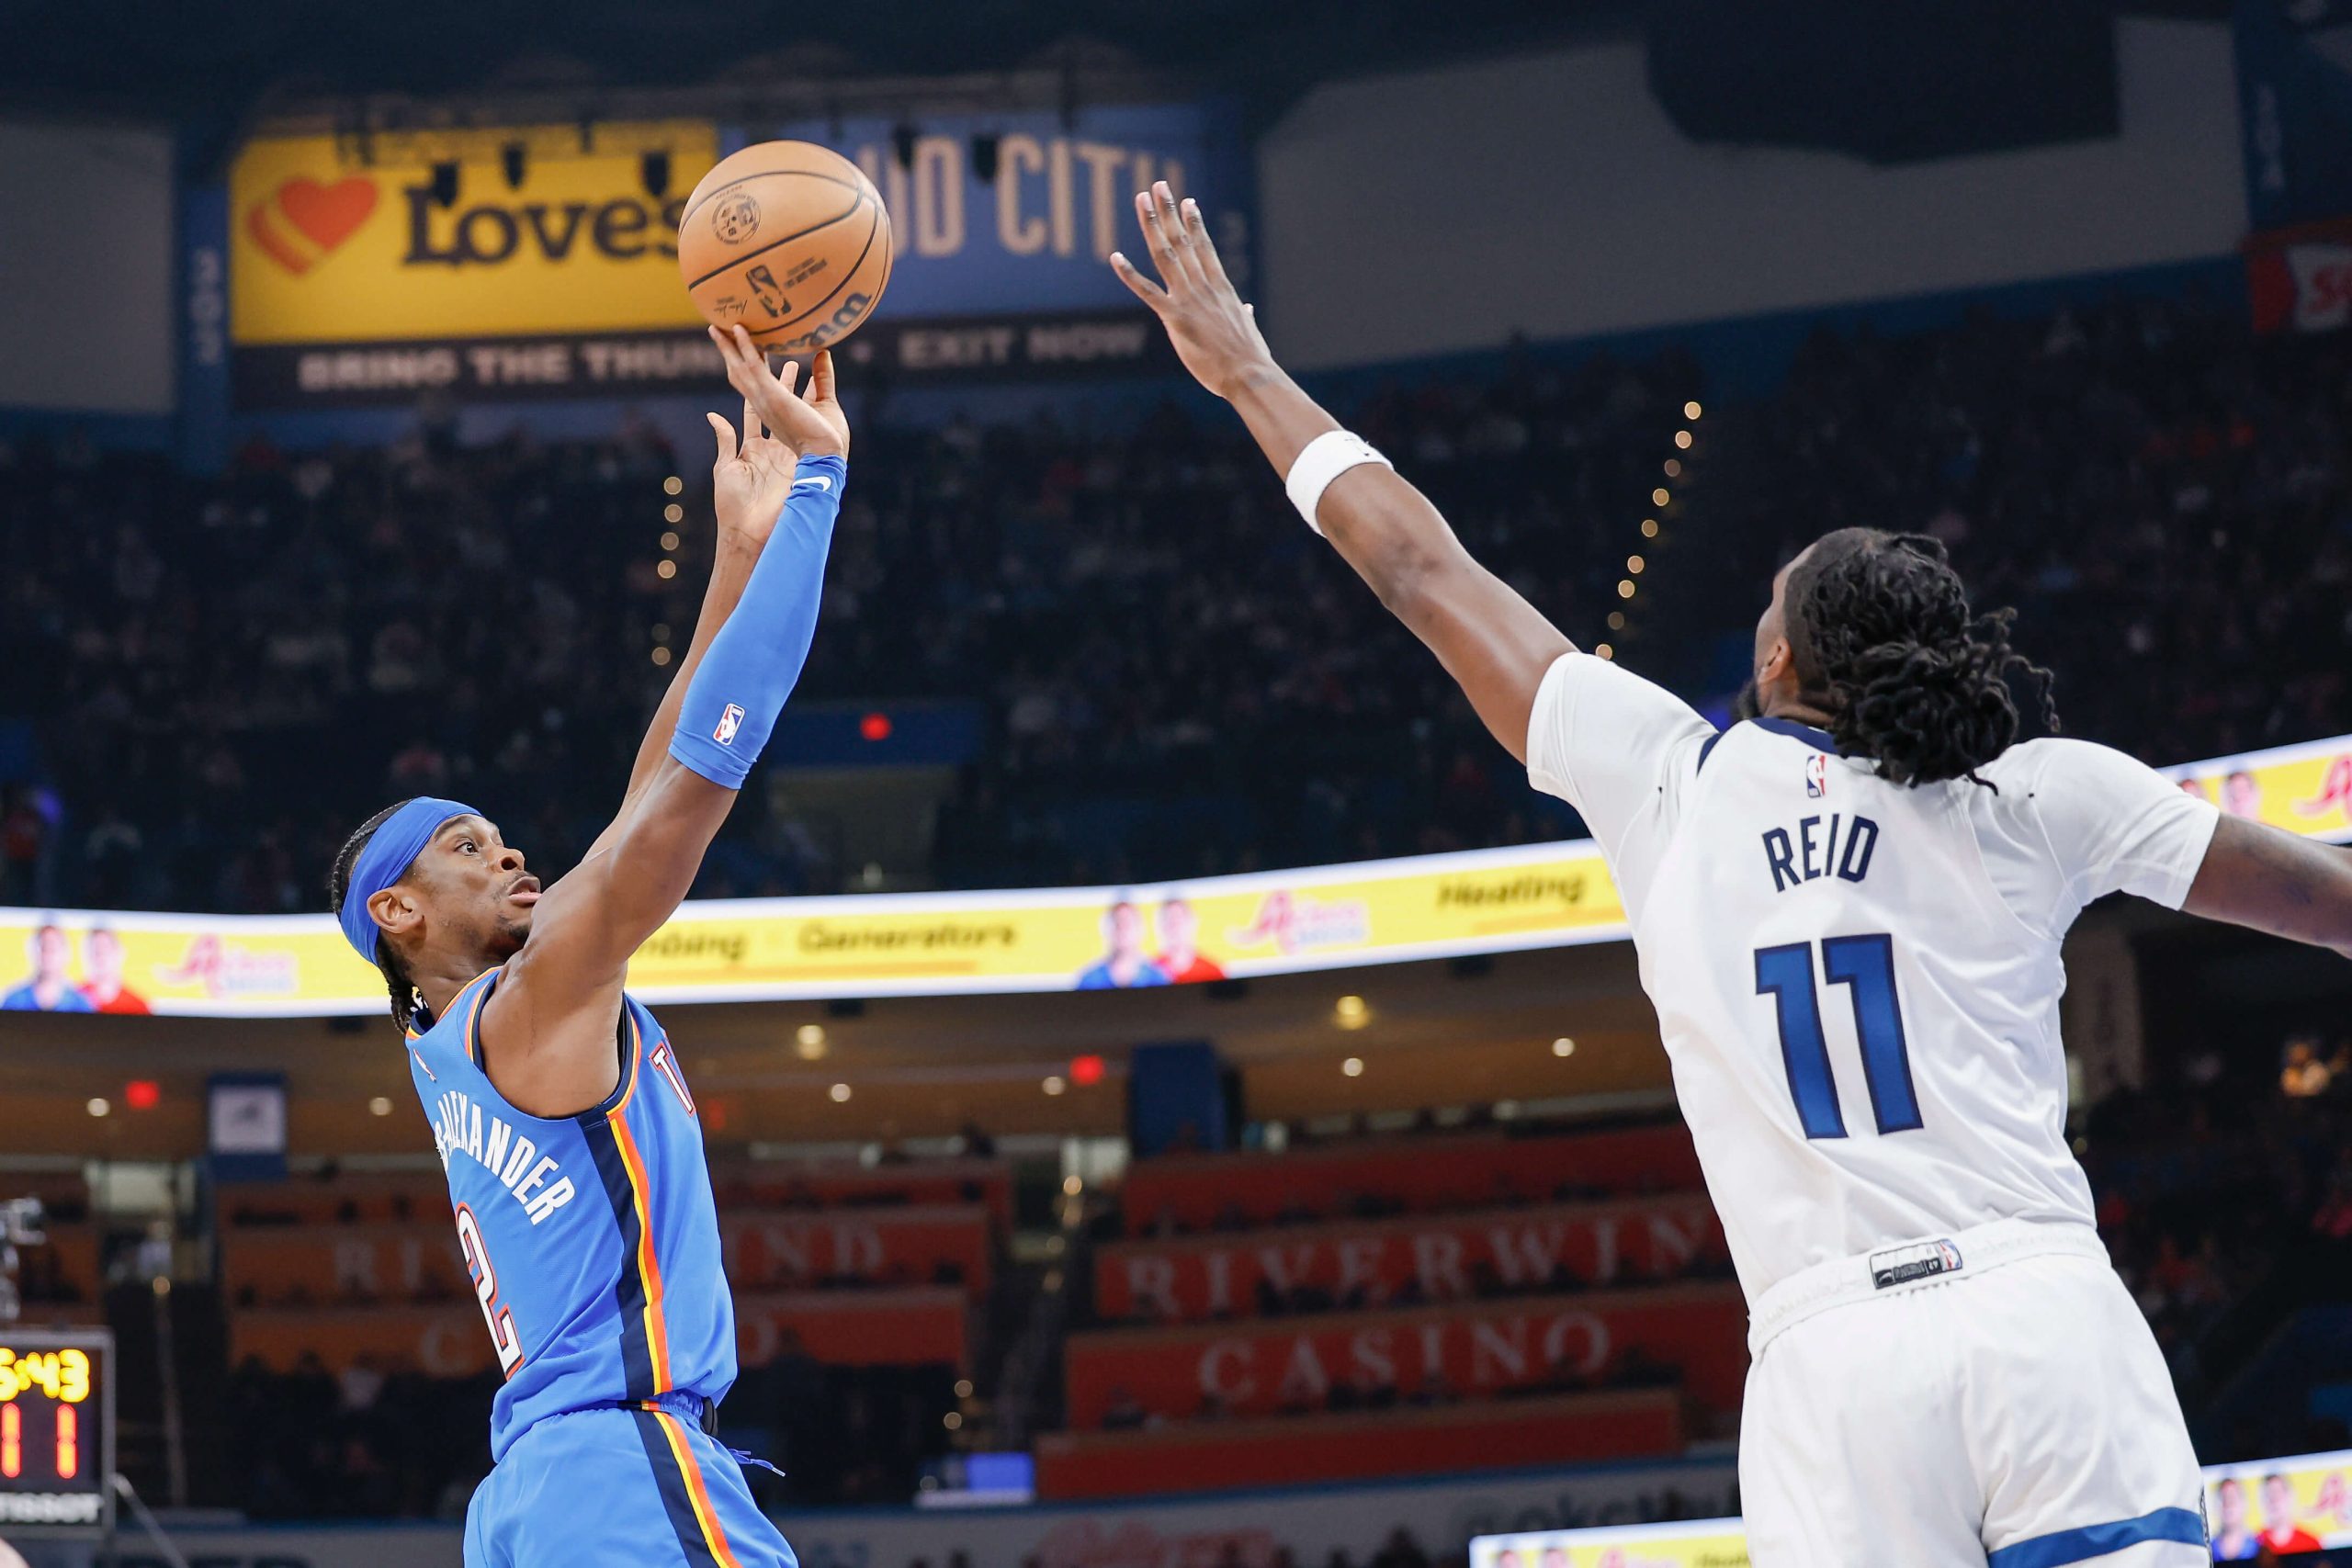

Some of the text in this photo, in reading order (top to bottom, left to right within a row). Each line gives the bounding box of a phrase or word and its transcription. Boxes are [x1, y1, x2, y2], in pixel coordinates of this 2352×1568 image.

[298, 345, 458, 393] BRING
[469, 343, 575, 388] THE
[1436, 873, 1589, 909] Heating
[1761, 813, 1880, 893] REID
[798, 919, 1016, 953] Generators
[1755, 933, 1924, 1141] 11
[455, 1201, 526, 1382] 2
[1126, 1211, 1716, 1317] RIVERWIN
[1199, 1310, 1612, 1402] CASINO
